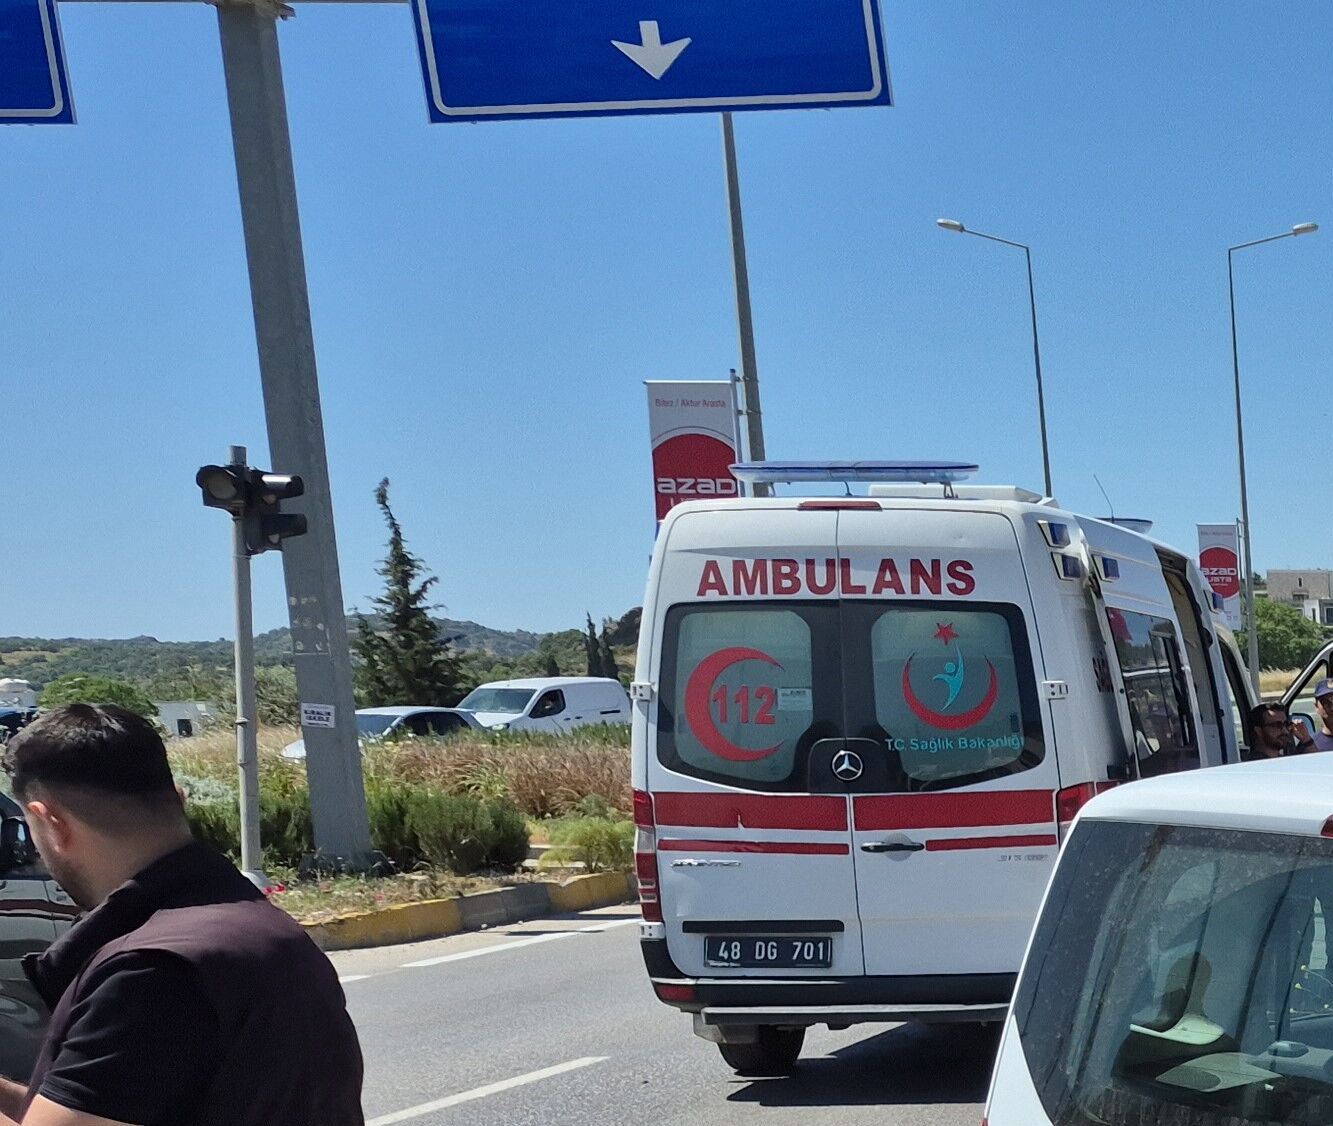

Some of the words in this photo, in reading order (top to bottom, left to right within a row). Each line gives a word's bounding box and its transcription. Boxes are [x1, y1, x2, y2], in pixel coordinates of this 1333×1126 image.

[696, 557, 977, 597] AMBULANS
[711, 684, 778, 725] 112
[909, 736, 952, 753] Sağlık
[717, 940, 742, 961] 48
[754, 940, 778, 961] DG
[791, 941, 825, 961] 701
